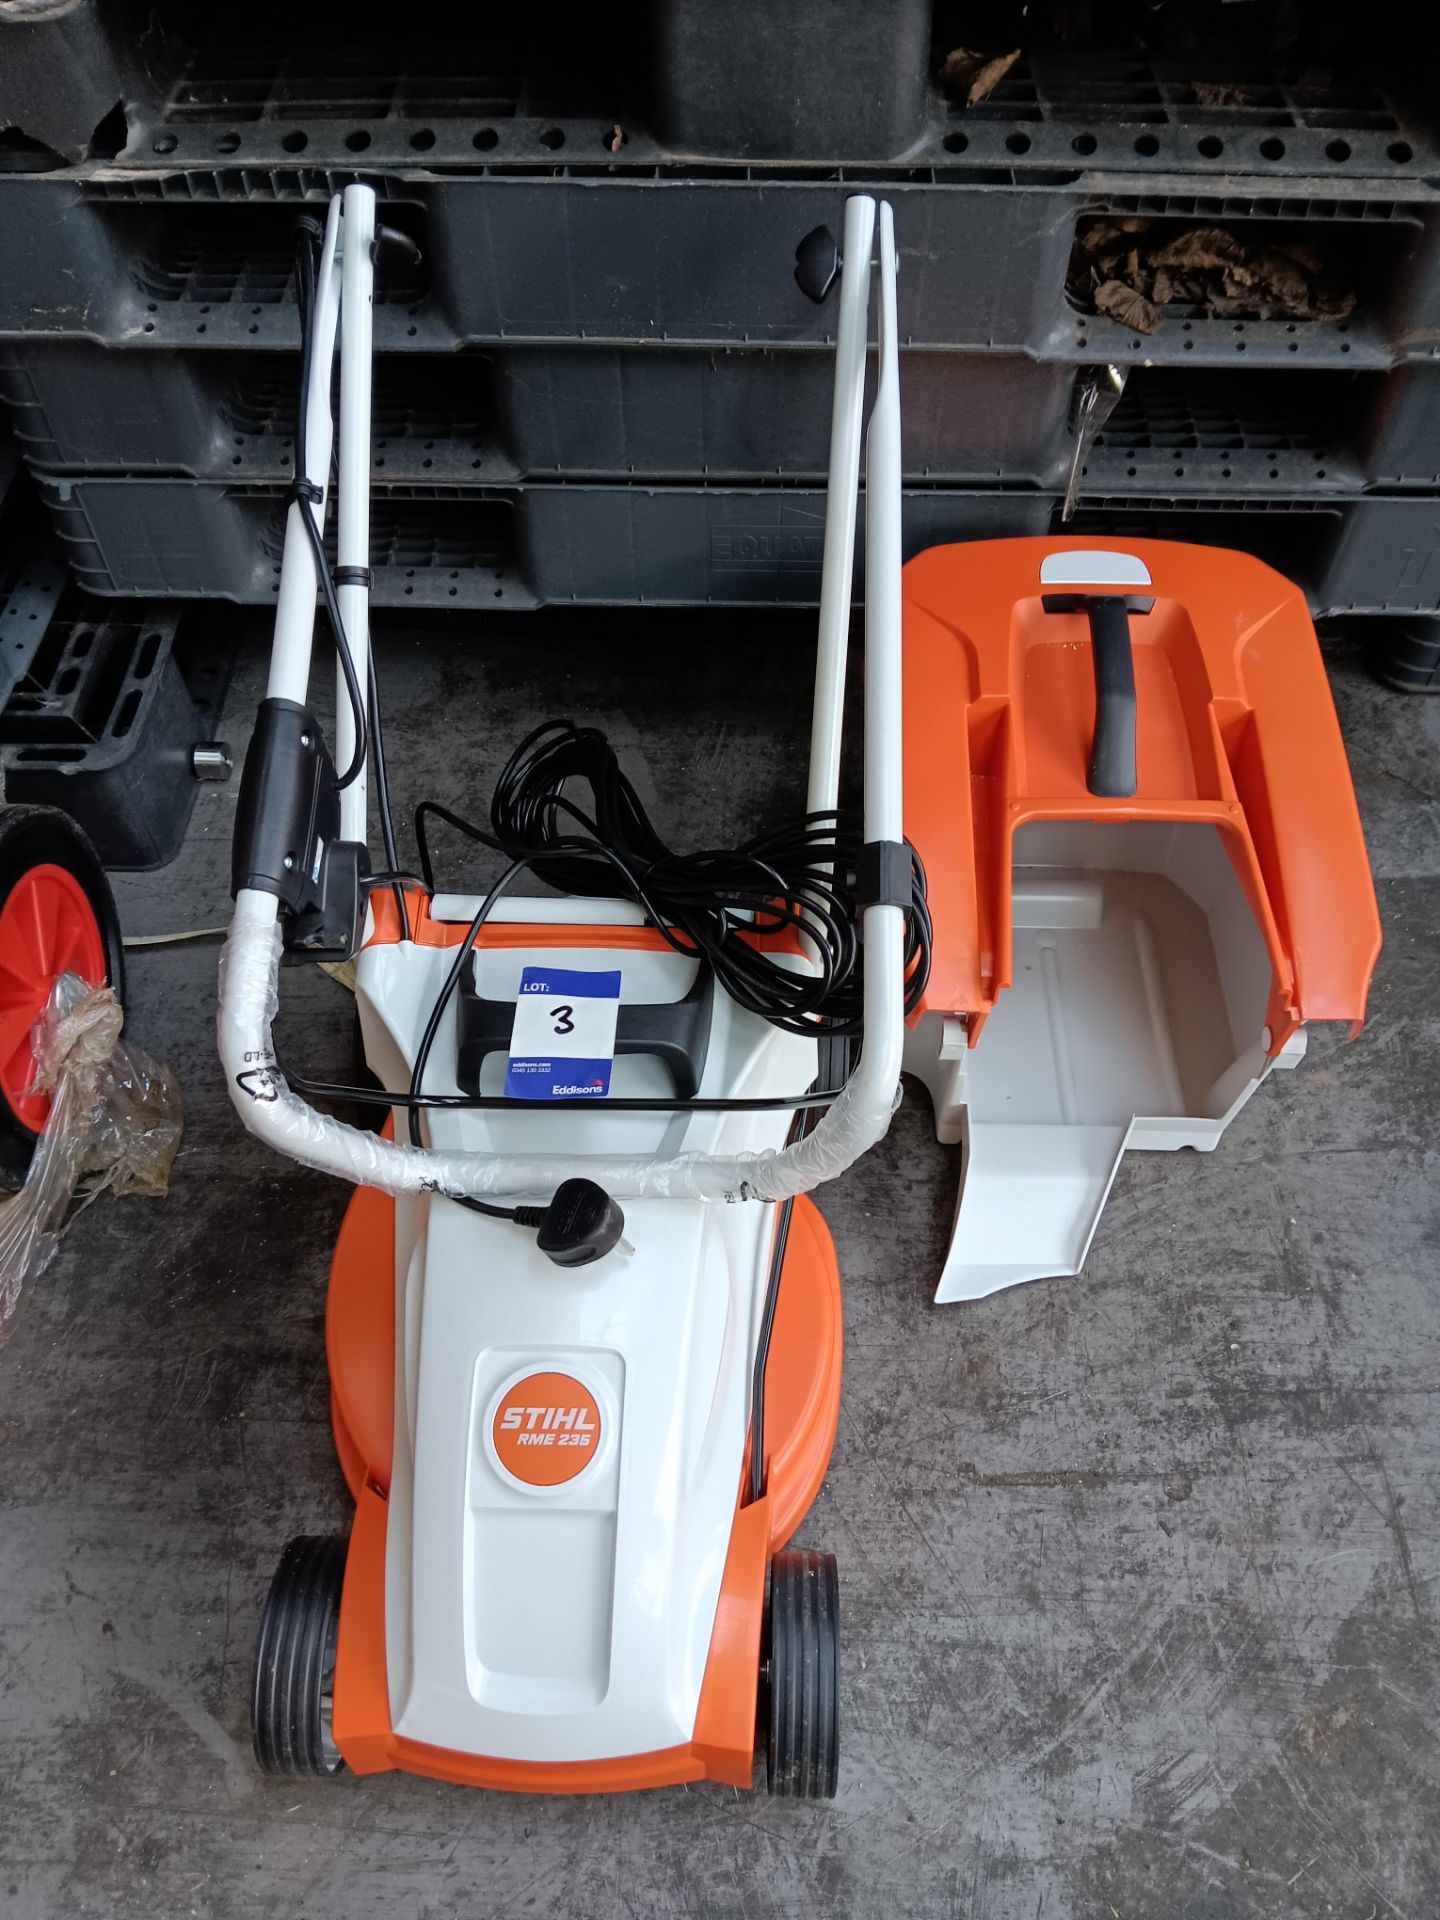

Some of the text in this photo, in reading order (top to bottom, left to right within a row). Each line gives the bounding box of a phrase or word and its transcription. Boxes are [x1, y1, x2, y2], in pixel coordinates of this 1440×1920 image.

[523, 982, 550, 992] LOT:
[550, 1005, 574, 1035] 3
[552, 1085, 603, 1095] Eddisons
[500, 1407, 596, 1431] STIHL
[517, 1433, 592, 1447] RME 235
